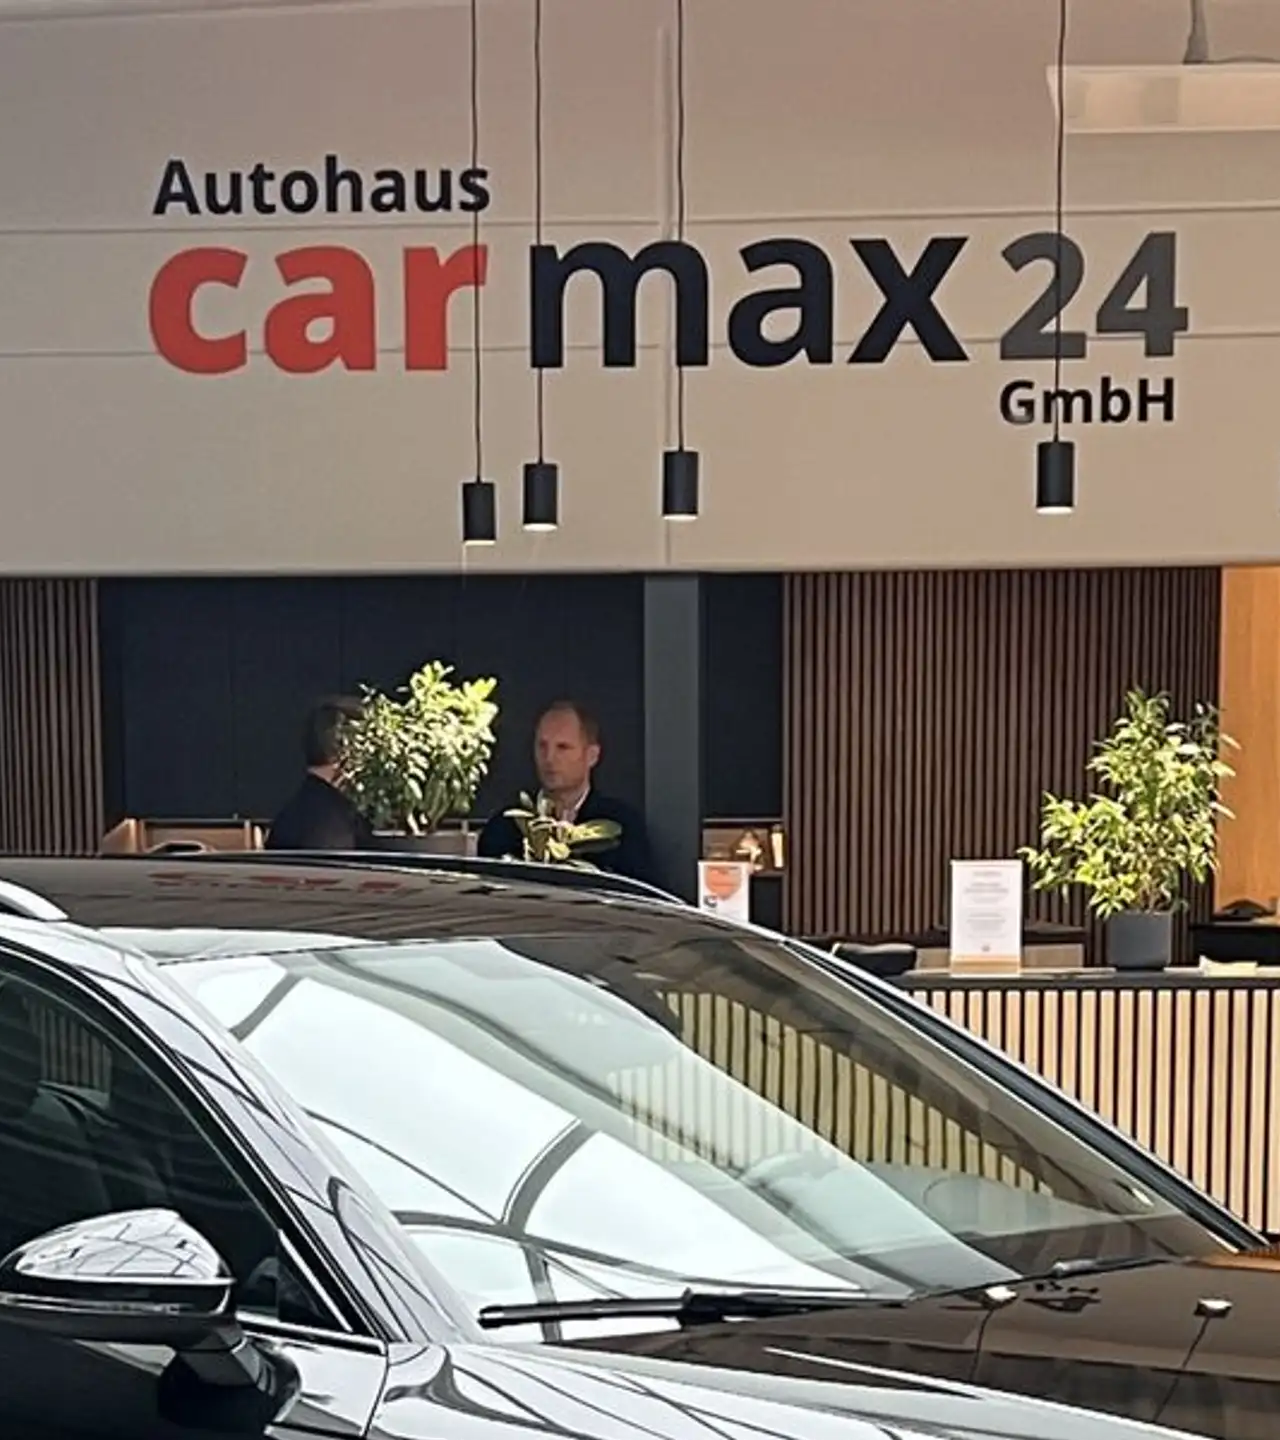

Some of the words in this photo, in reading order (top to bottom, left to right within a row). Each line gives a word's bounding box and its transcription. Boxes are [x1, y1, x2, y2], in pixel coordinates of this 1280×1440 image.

[151, 154, 492, 216] Autohaus
[998, 229, 1191, 361] 24
[999, 376, 1176, 426] GmbH
